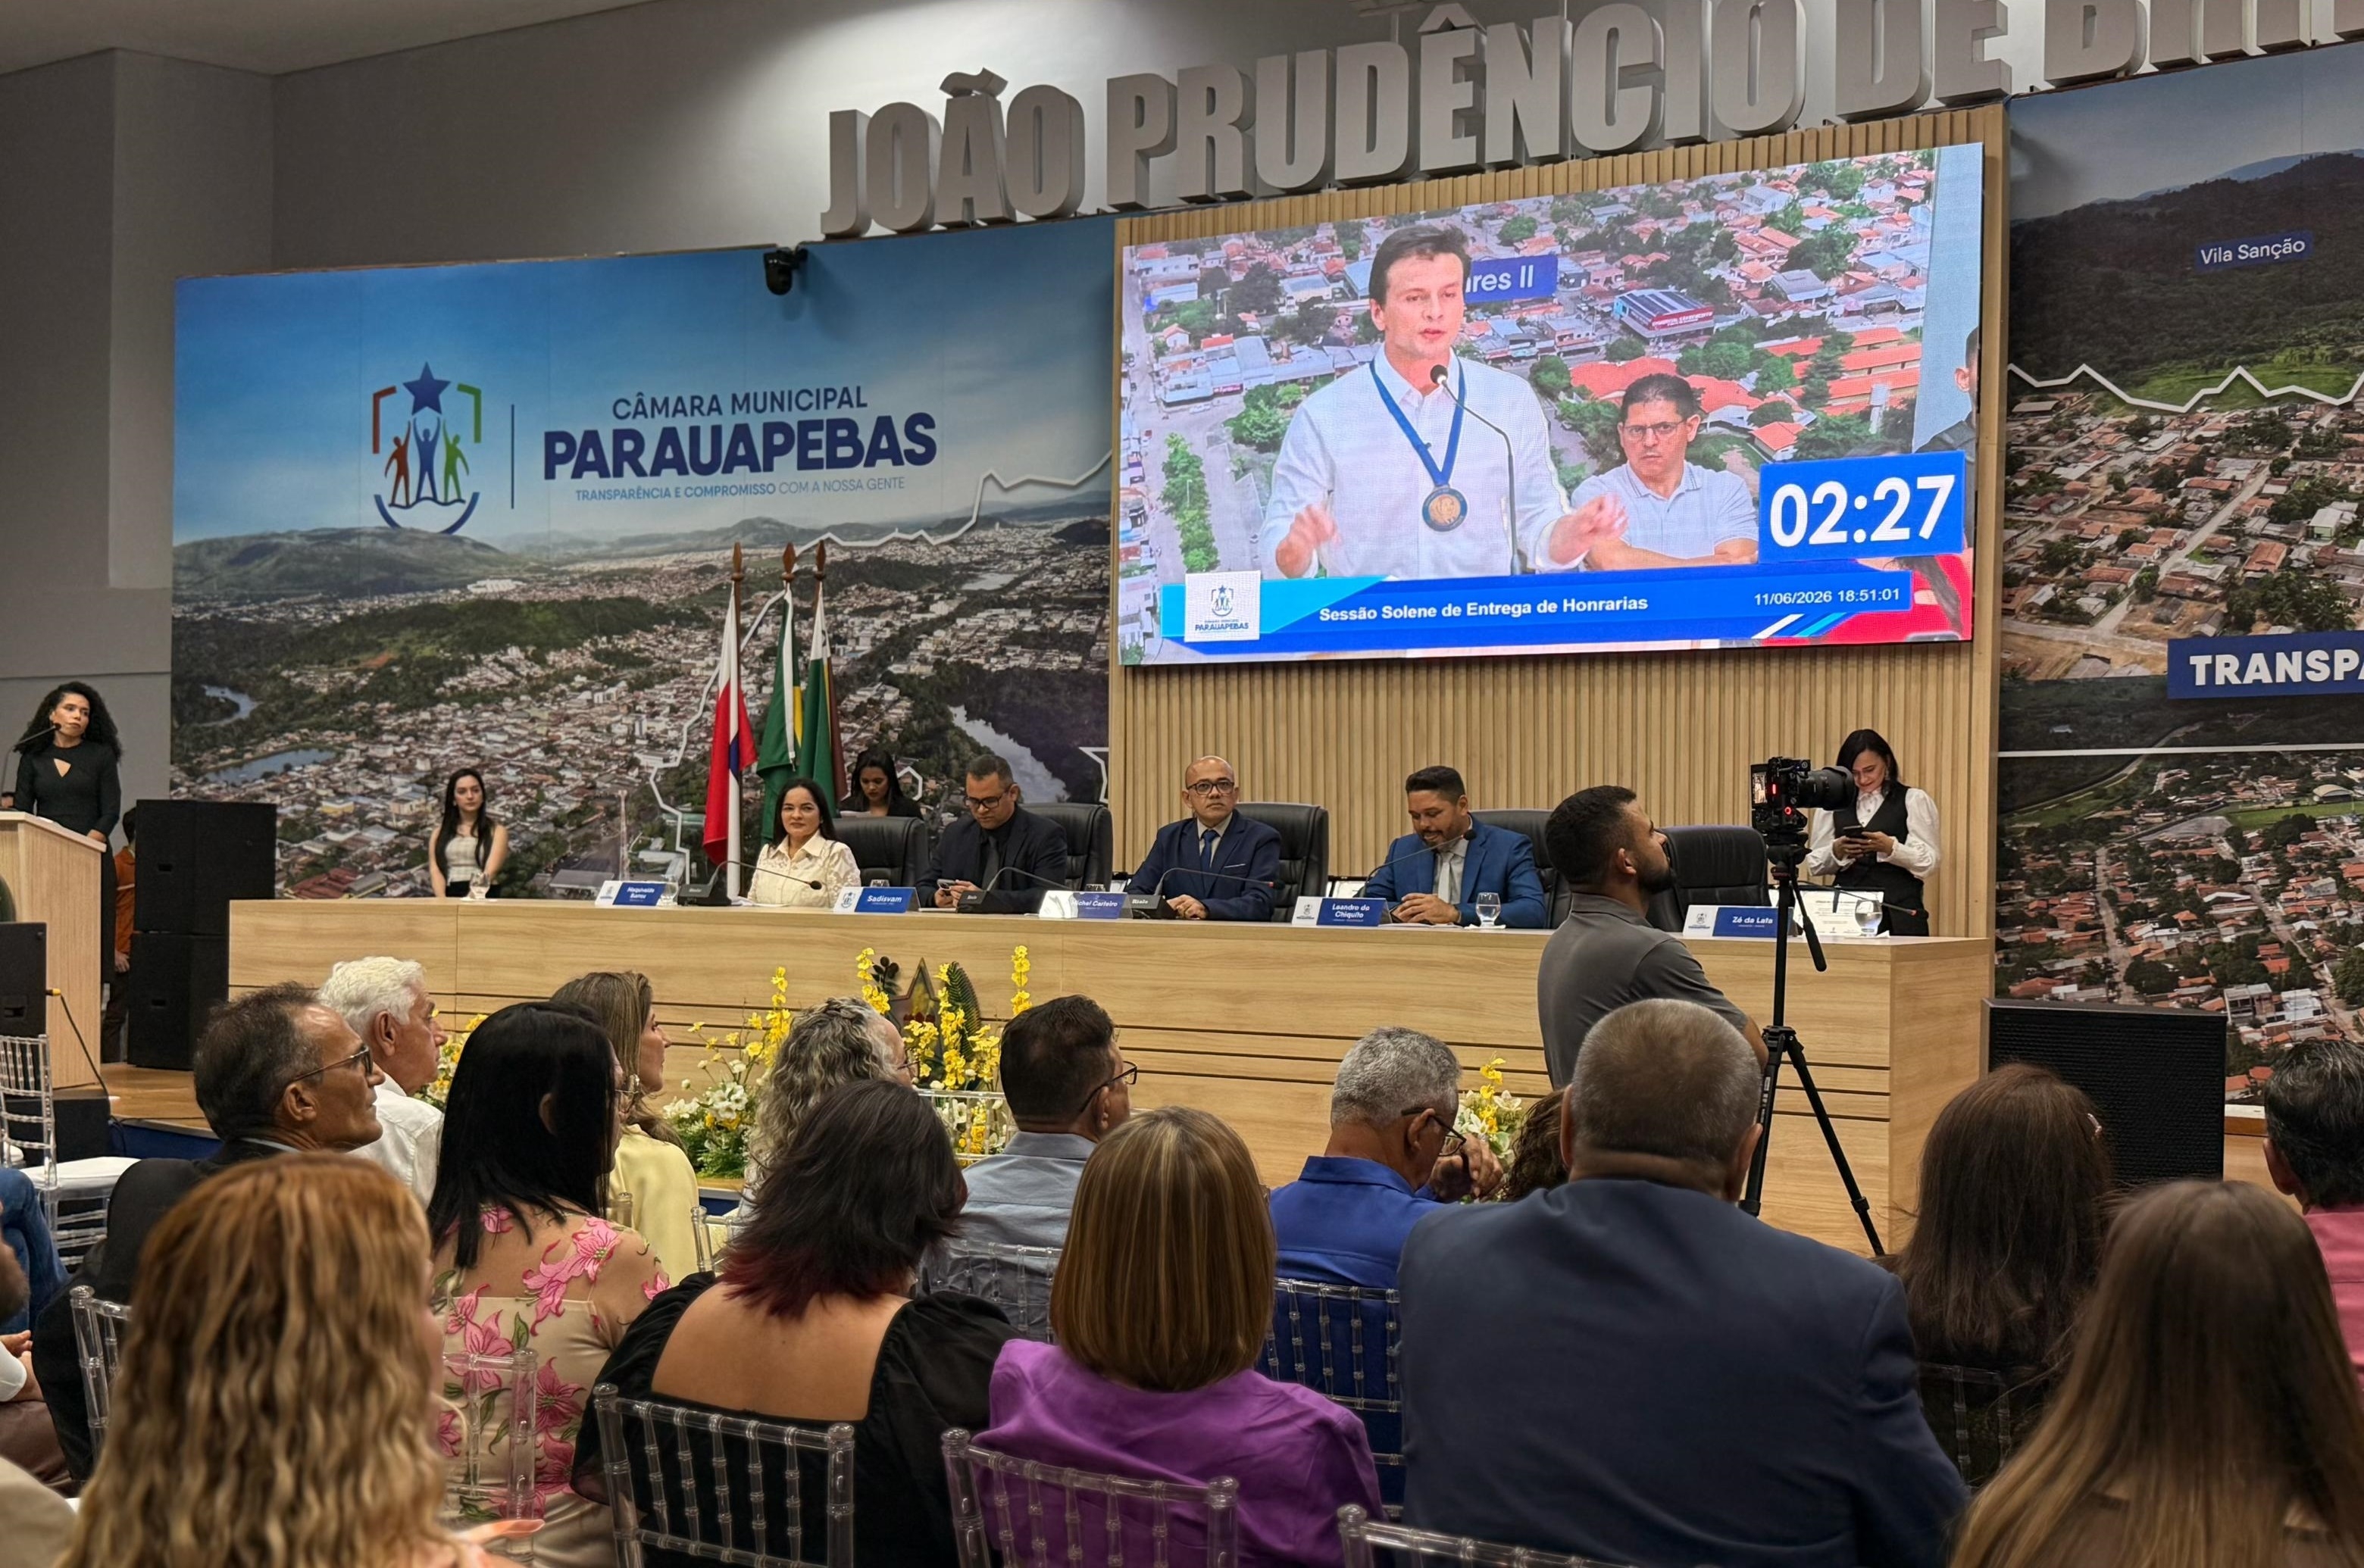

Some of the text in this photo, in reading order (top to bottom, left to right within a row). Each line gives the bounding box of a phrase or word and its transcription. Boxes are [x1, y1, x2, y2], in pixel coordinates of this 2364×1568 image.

[821, 67, 1085, 237] JOÃO
[1106, 0, 1806, 209] PRUDÊNCIO
[1836, 0, 2012, 121] DE
[2200, 238, 2306, 265] Vila Sanção
[612, 386, 868, 420] CÂMARA MUNICIPAL
[543, 412, 937, 480] PARAUAPEBAS
[576, 476, 906, 501] TRANSPARÊNCIA E COMPROMISSO COM A NOSSA GENTE
[1770, 474, 1956, 548] 02:27
[1319, 595, 1649, 623] Sessão Solene de Entrega de Honrarias
[1754, 588, 1900, 605] 11/06/2026 18:51:01
[2190, 649, 2364, 686] TRANSP
